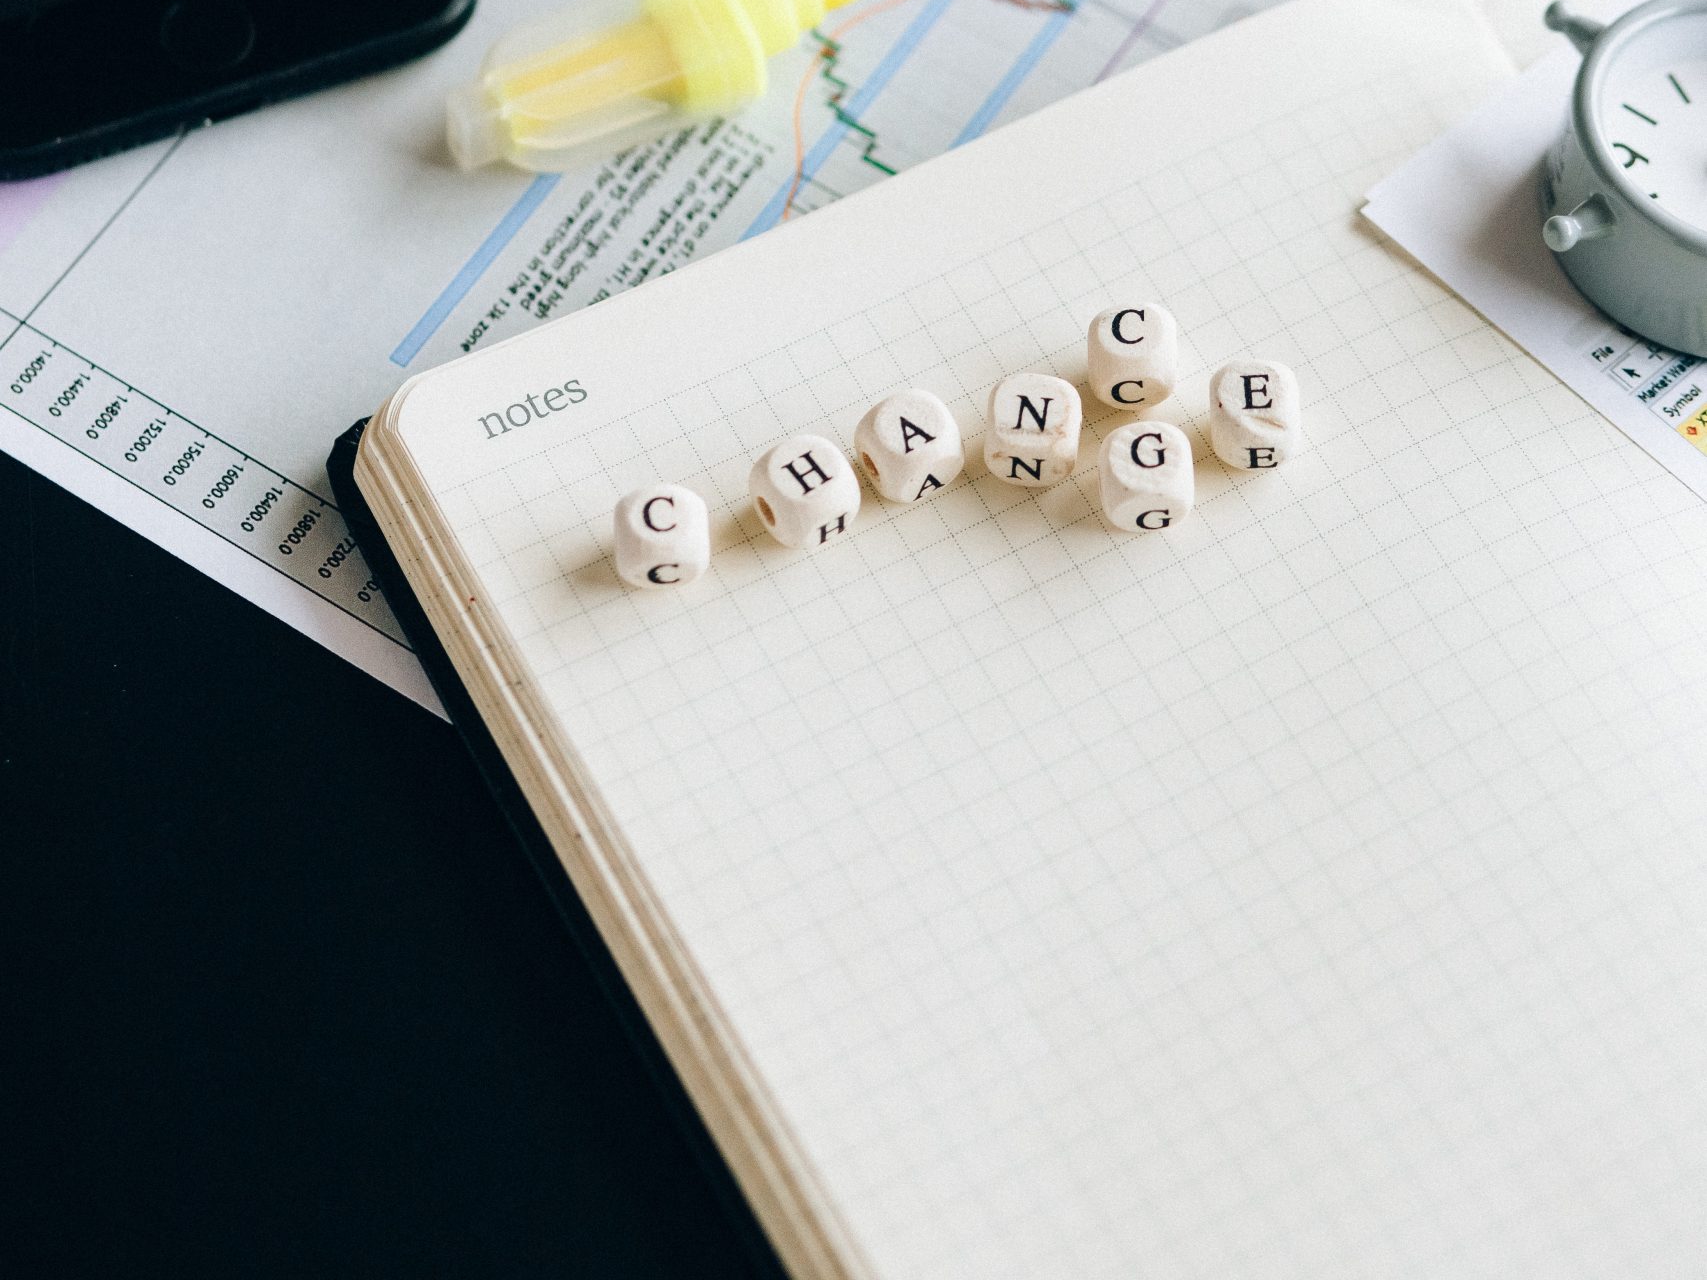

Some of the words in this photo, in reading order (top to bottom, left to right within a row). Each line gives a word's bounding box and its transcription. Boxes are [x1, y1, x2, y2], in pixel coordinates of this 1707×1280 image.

[508, 274, 530, 295] the
[528, 257, 543, 271] in
[486, 298, 510, 320] 13k
[520, 270, 552, 311] greed
[534, 290, 563, 319] high
[460, 321, 489, 352] zone
[1111, 309, 1145, 345] C
[11, 351, 52, 394] 14000.0
[1591, 346, 1615, 362] File
[49, 373, 90, 417] 14400.0
[478, 379, 588, 440] notes
[1111, 380, 1145, 404] C
[1637, 373, 1673, 404] Market
[1663, 384, 1703, 418] Symbol
[86, 396, 128, 439] 14800.0
[125, 419, 166, 463] 15200.0
[642, 497, 677, 532] C
[781, 450, 833, 495] H
[900, 416, 936, 454] A
[1015, 394, 1054, 433] N
[1131, 432, 1166, 469] G
[1240, 373, 1274, 411] E
[163, 441, 205, 486] 15600.0
[202, 464, 244, 509] 16000.0
[241, 487, 283, 532] 16400.0
[647, 563, 680, 585] C
[818, 513, 847, 545] H
[913, 474, 945, 501] A
[1006, 456, 1045, 481] N
[1135, 509, 1173, 531] G
[1246, 447, 1279, 469] E
[279, 509, 321, 555] 16800.0
[318, 532, 359, 579] 7200.0
